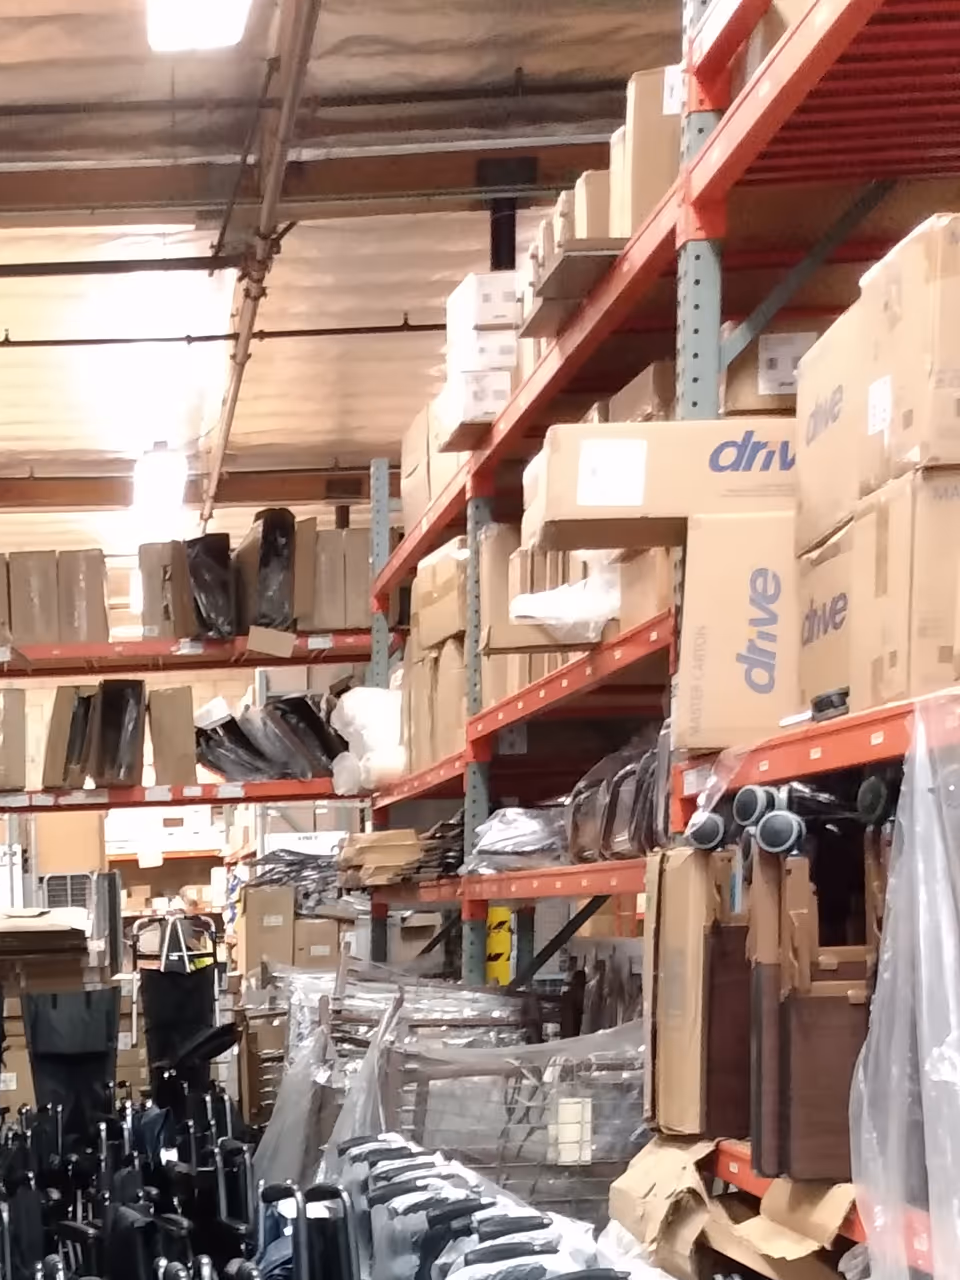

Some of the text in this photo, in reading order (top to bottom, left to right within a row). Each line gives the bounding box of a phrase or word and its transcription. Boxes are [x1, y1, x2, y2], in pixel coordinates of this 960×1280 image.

[708, 430, 795, 473] driv
[735, 567, 782, 694] drive
[802, 592, 848, 647] drive
